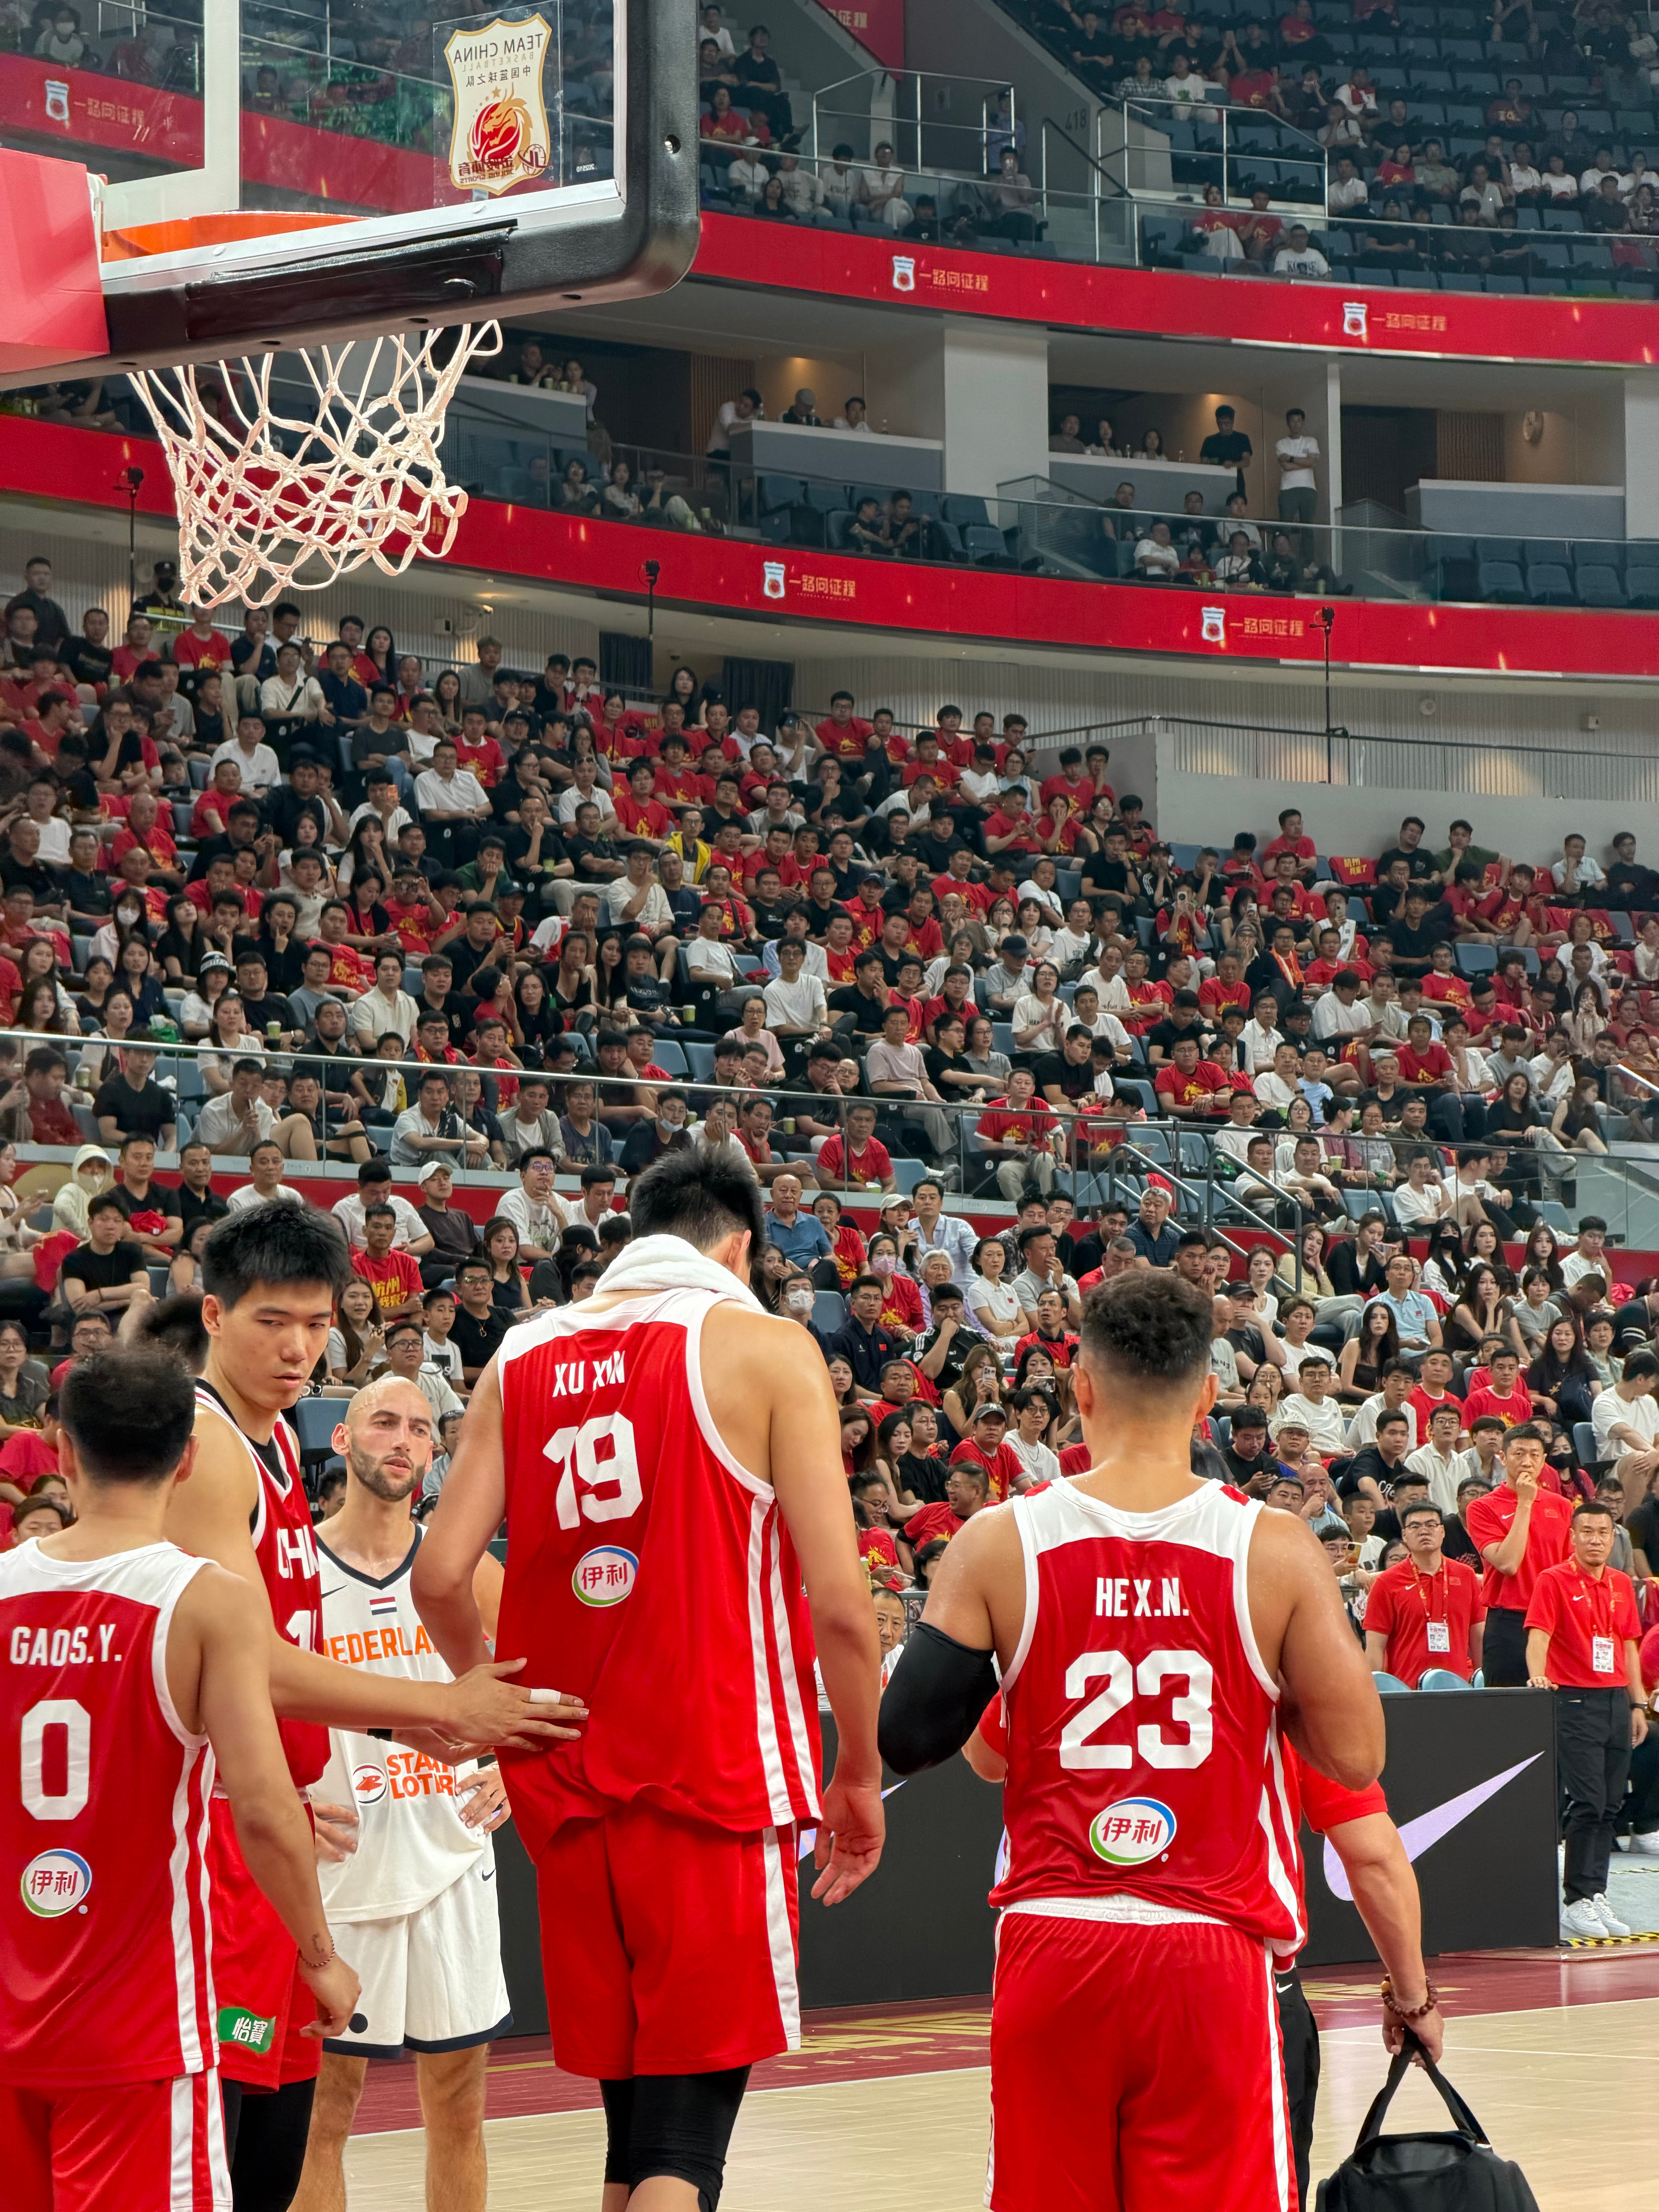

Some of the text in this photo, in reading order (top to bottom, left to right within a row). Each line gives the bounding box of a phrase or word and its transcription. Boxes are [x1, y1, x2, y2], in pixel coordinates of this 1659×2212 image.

[1065, 109, 1086, 130] 418
[372, 1276, 400, 1297] 杭州
[552, 1361, 585, 1398] XU
[543, 1411, 643, 1530] 19
[581, 1562, 628, 1590] 伊利
[286, 1609, 317, 1654] 1
[323, 1625, 438, 1664] EDERLA
[1060, 1650, 1213, 1769] 23
[21, 1699, 91, 1820] 0
[1102, 1817, 1163, 1845] 伊利
[30, 1870, 79, 1896] 伊利
[232, 2017, 268, 2045] 怡寶
